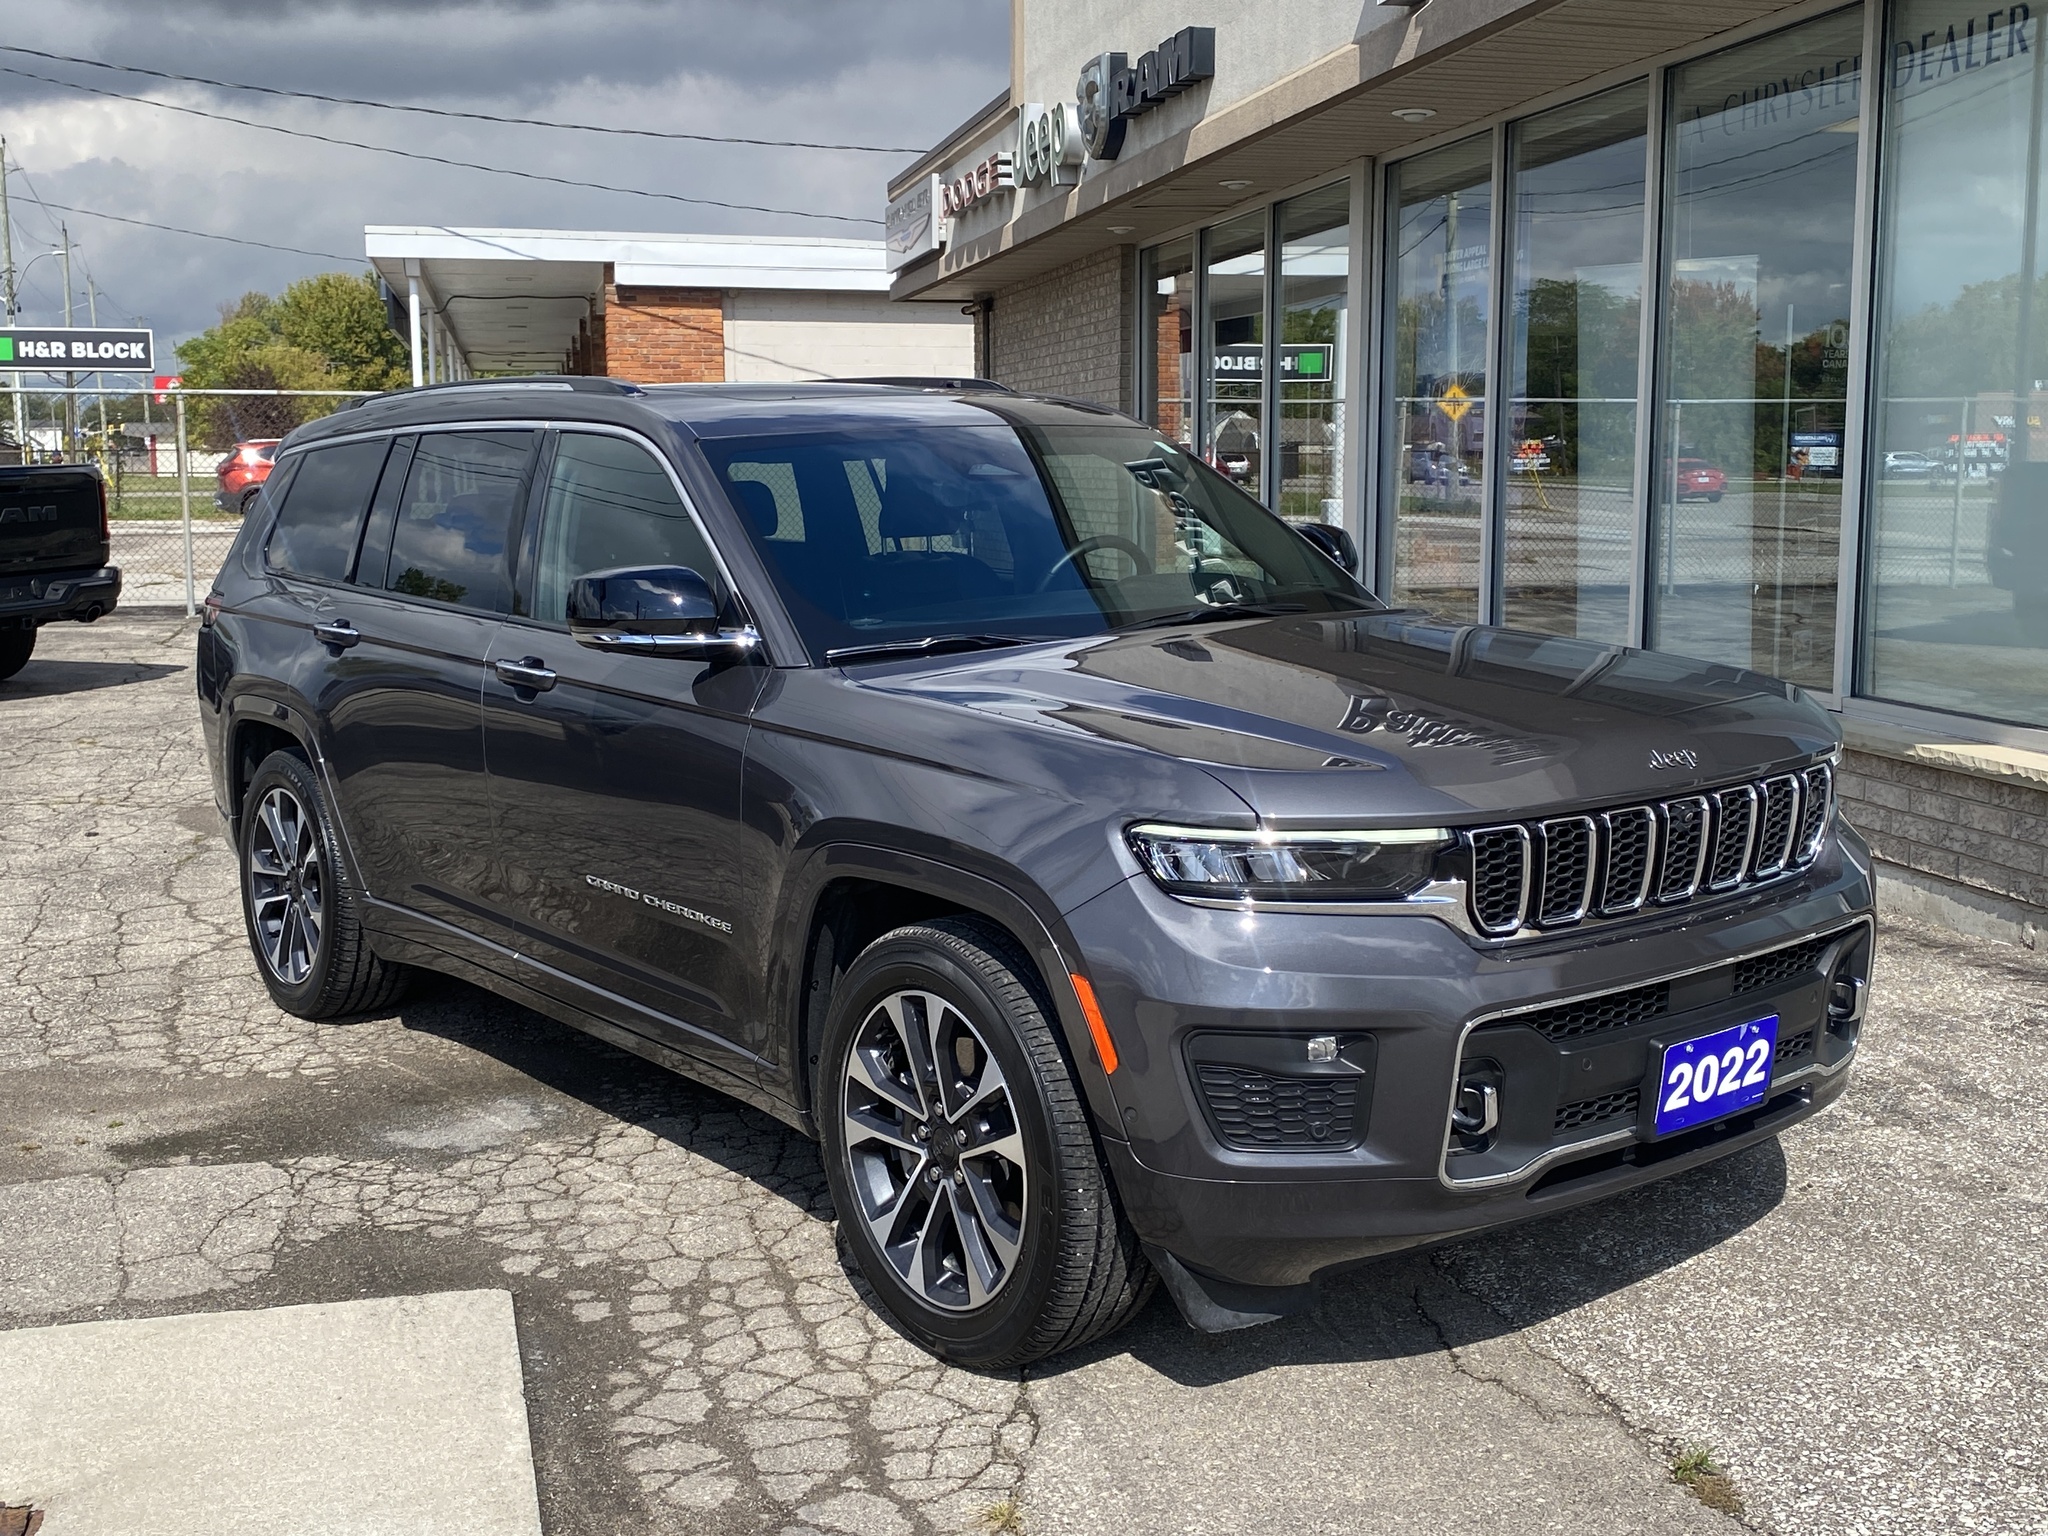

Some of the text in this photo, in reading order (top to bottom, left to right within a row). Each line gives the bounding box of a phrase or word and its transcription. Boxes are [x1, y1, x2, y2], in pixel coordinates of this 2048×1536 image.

[1109, 26, 1196, 120] RAM
[1891, 2, 2031, 90] DEALER
[1012, 101, 1070, 188] Jeep
[942, 152, 999, 218] DODGE
[18, 340, 146, 359] H&R BLOCK
[0, 505, 57, 523] AM
[1648, 748, 1700, 770] Jeep
[585, 874, 734, 935] GRAND CHEROKEE
[1663, 1038, 1770, 1113] 2022
